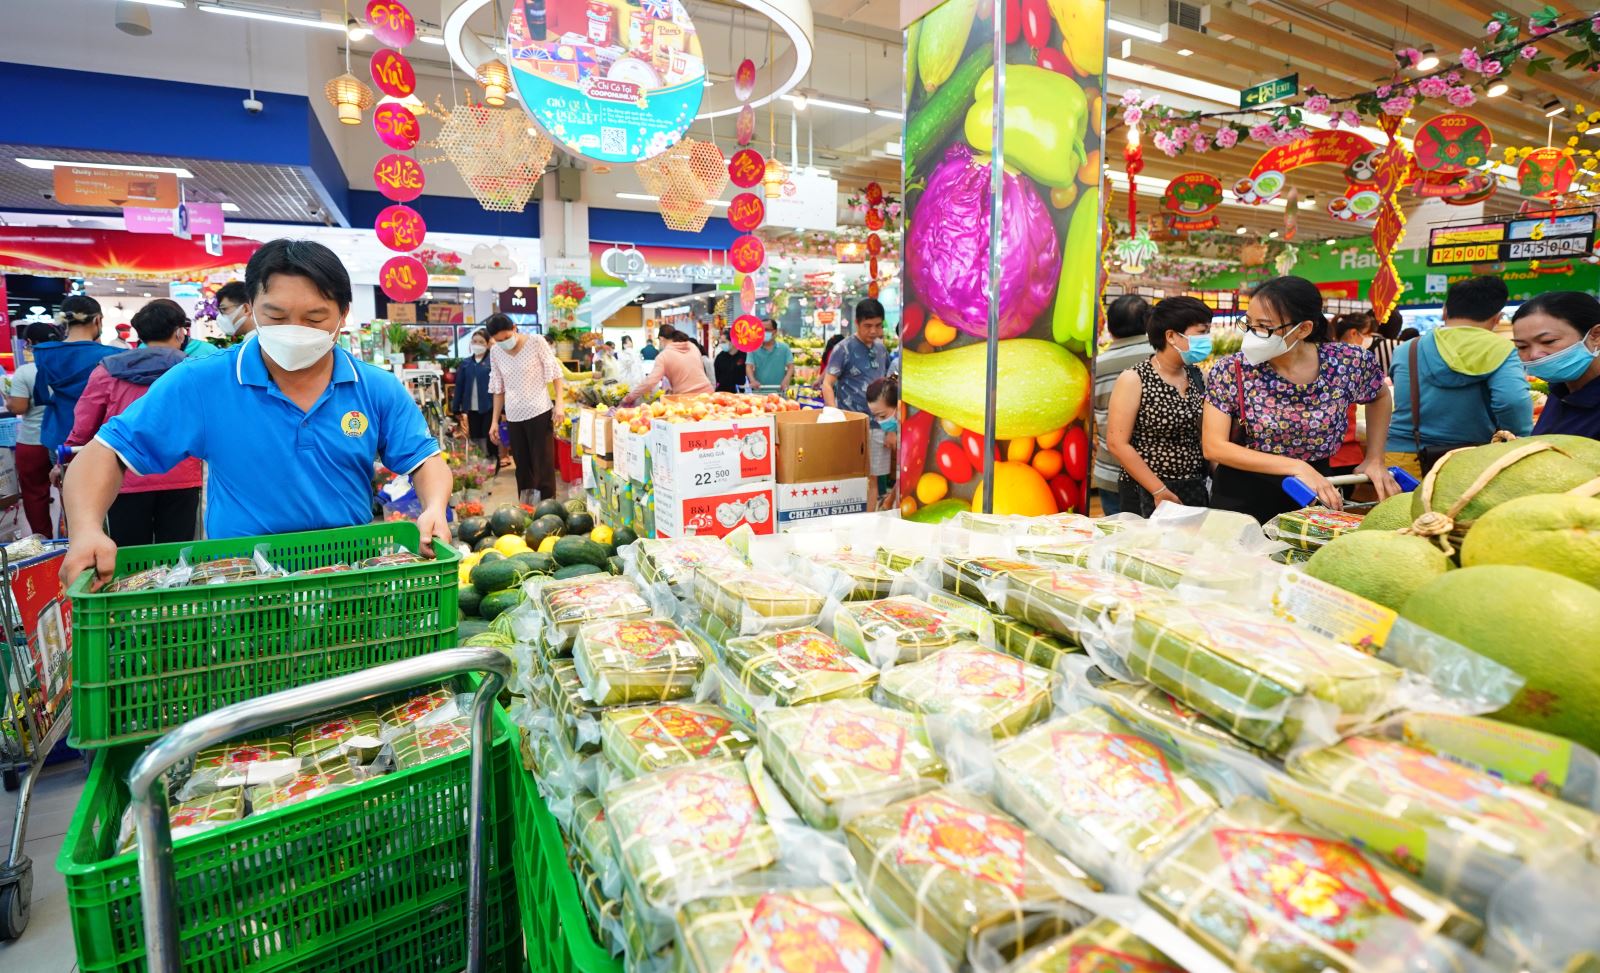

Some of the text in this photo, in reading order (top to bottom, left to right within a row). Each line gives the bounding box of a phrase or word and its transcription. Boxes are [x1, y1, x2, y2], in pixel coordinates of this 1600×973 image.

[376, 55, 411, 93] Vui
[611, 82, 620, 91] Có
[621, 84, 632, 93] Tại
[1276, 82, 1290, 93] EXIT
[1441, 118, 1468, 127] 2023
[688, 439, 708, 449] B&J
[690, 506, 710, 516] B&J
[788, 504, 862, 520] CHELAN STARR
